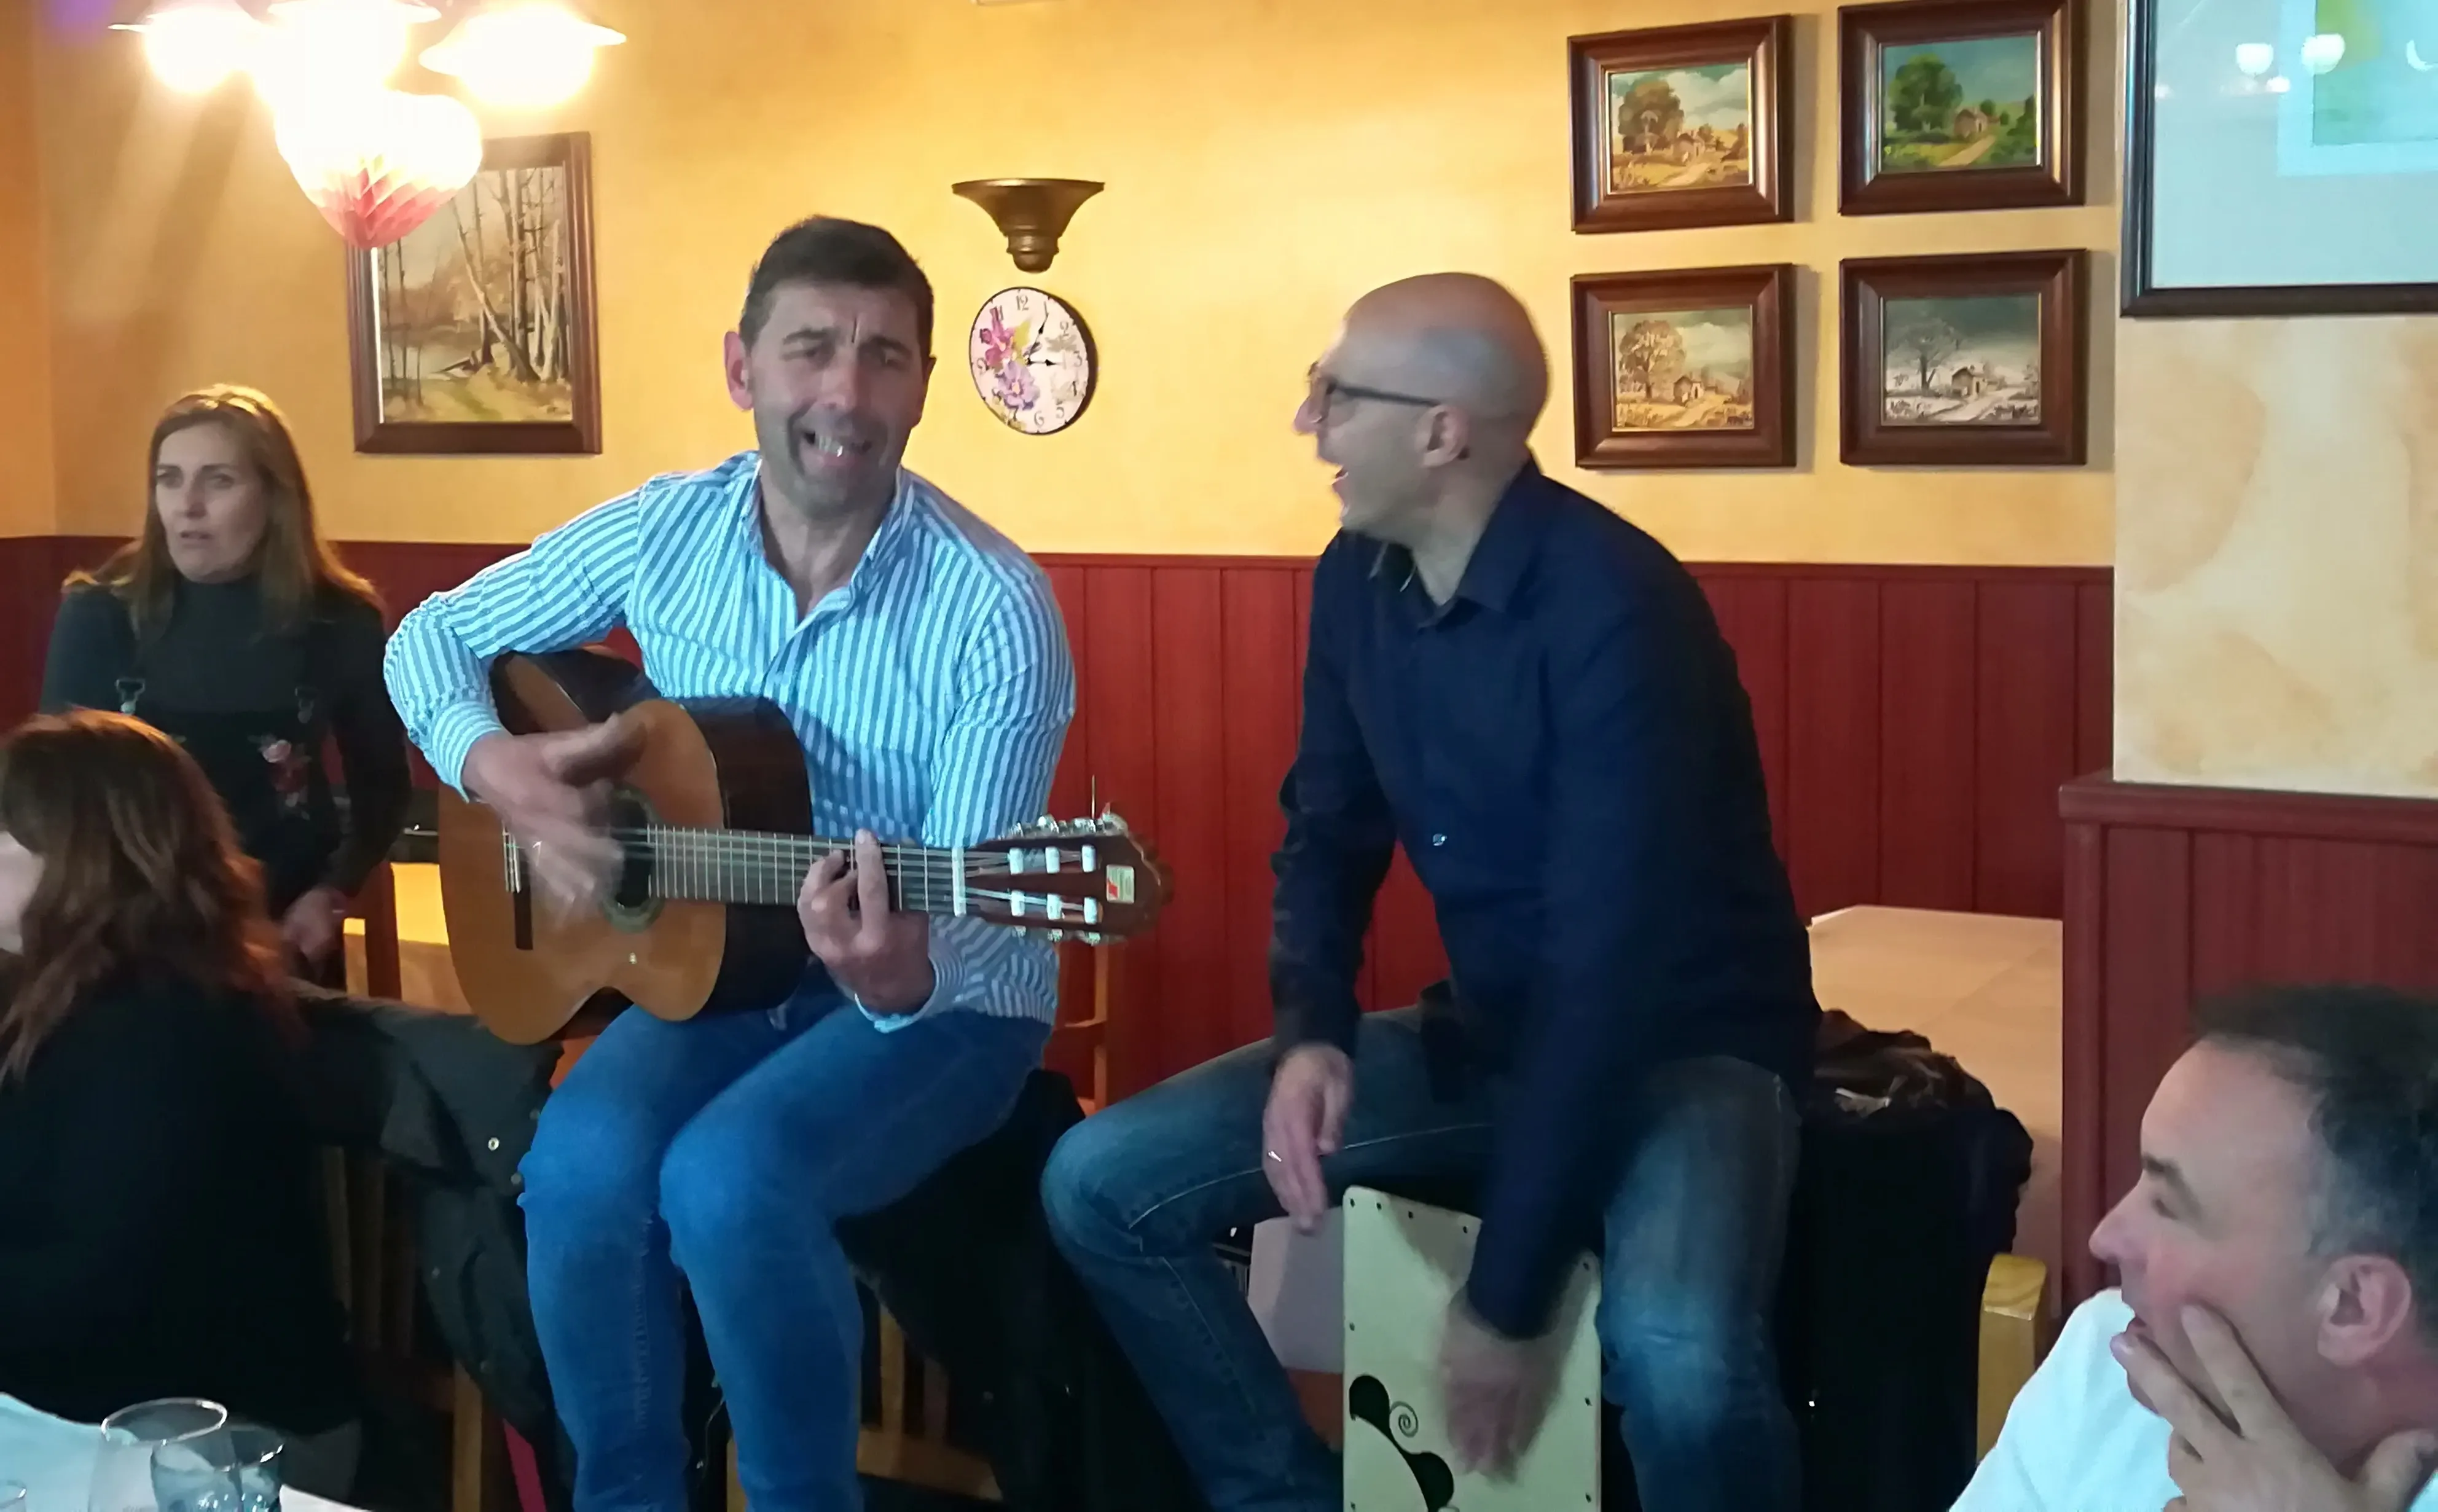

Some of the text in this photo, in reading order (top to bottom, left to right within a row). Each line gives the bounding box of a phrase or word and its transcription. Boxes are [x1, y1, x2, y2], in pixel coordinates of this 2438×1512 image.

[1016, 295, 1029, 311] 12
[1059, 320, 1070, 337] 2
[1073, 351, 1083, 367] 3
[1056, 399, 1065, 419] 5
[1033, 410, 1045, 427] 6
